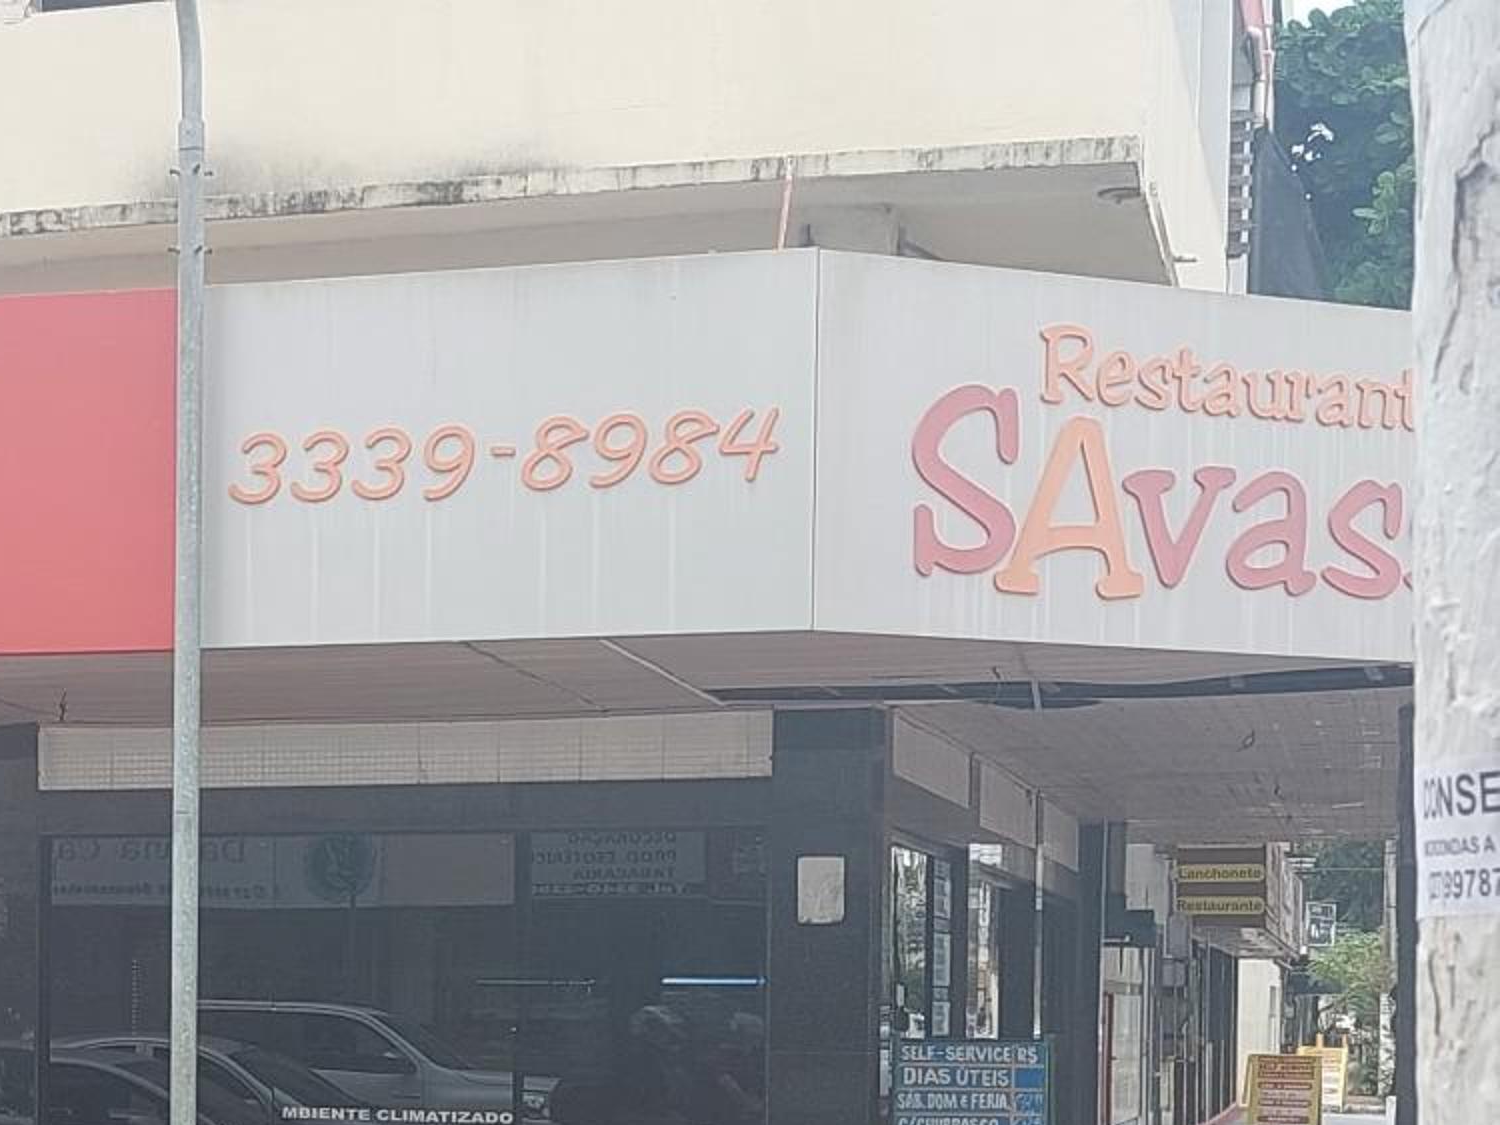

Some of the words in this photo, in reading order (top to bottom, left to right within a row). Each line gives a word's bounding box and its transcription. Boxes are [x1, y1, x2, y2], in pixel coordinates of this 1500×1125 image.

[1040, 322, 1415, 431] Restaurant
[227, 406, 780, 505] 3339-8984
[911, 384, 1415, 600] SAvas
[1180, 867, 1262, 879] Lanchonete
[1177, 900, 1262, 911] Restaurante
[900, 1045, 1011, 1061] SELF-SERVICE
[903, 1067, 951, 1085] DIAS
[376, 1109, 513, 1124] CLIMATIZADO
